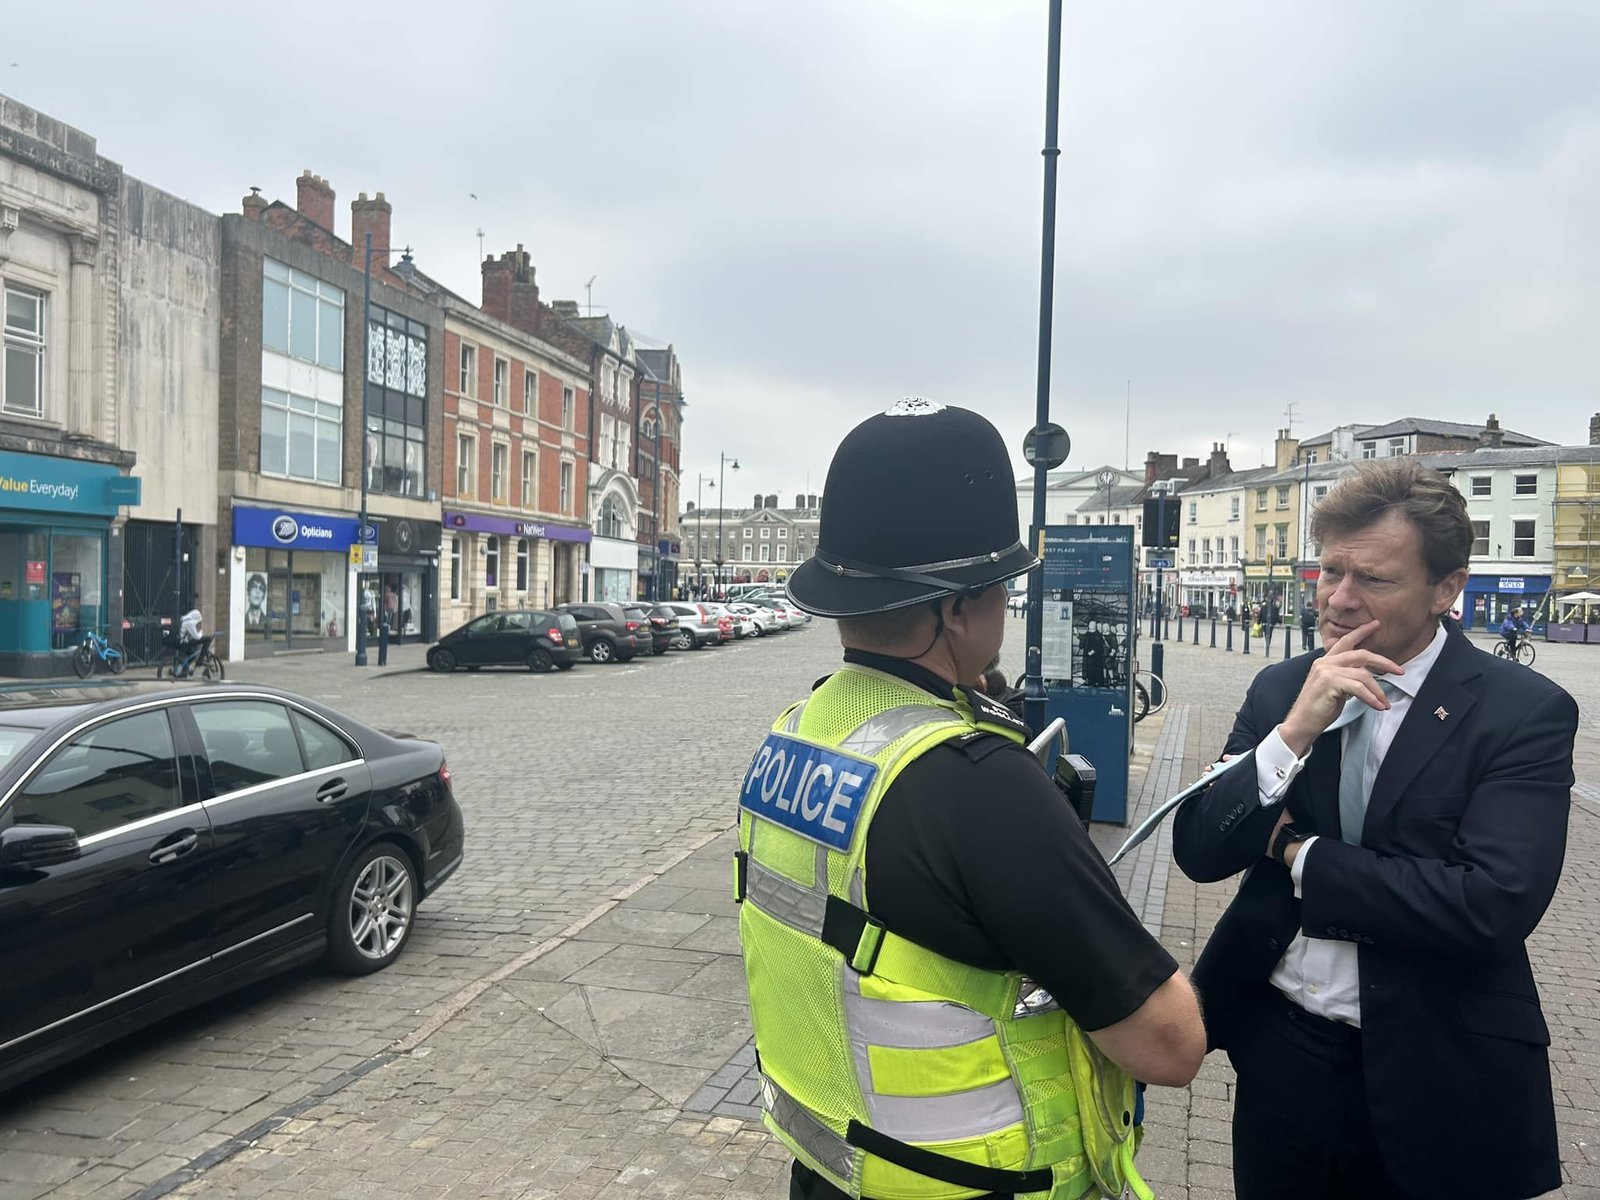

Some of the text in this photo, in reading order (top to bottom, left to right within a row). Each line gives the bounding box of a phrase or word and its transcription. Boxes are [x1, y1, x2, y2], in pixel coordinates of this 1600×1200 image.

[30, 479, 79, 500] Everyday!
[301, 525, 333, 539] Opticians
[522, 523, 545, 537] NatWest
[745, 746, 863, 834] POLICE
